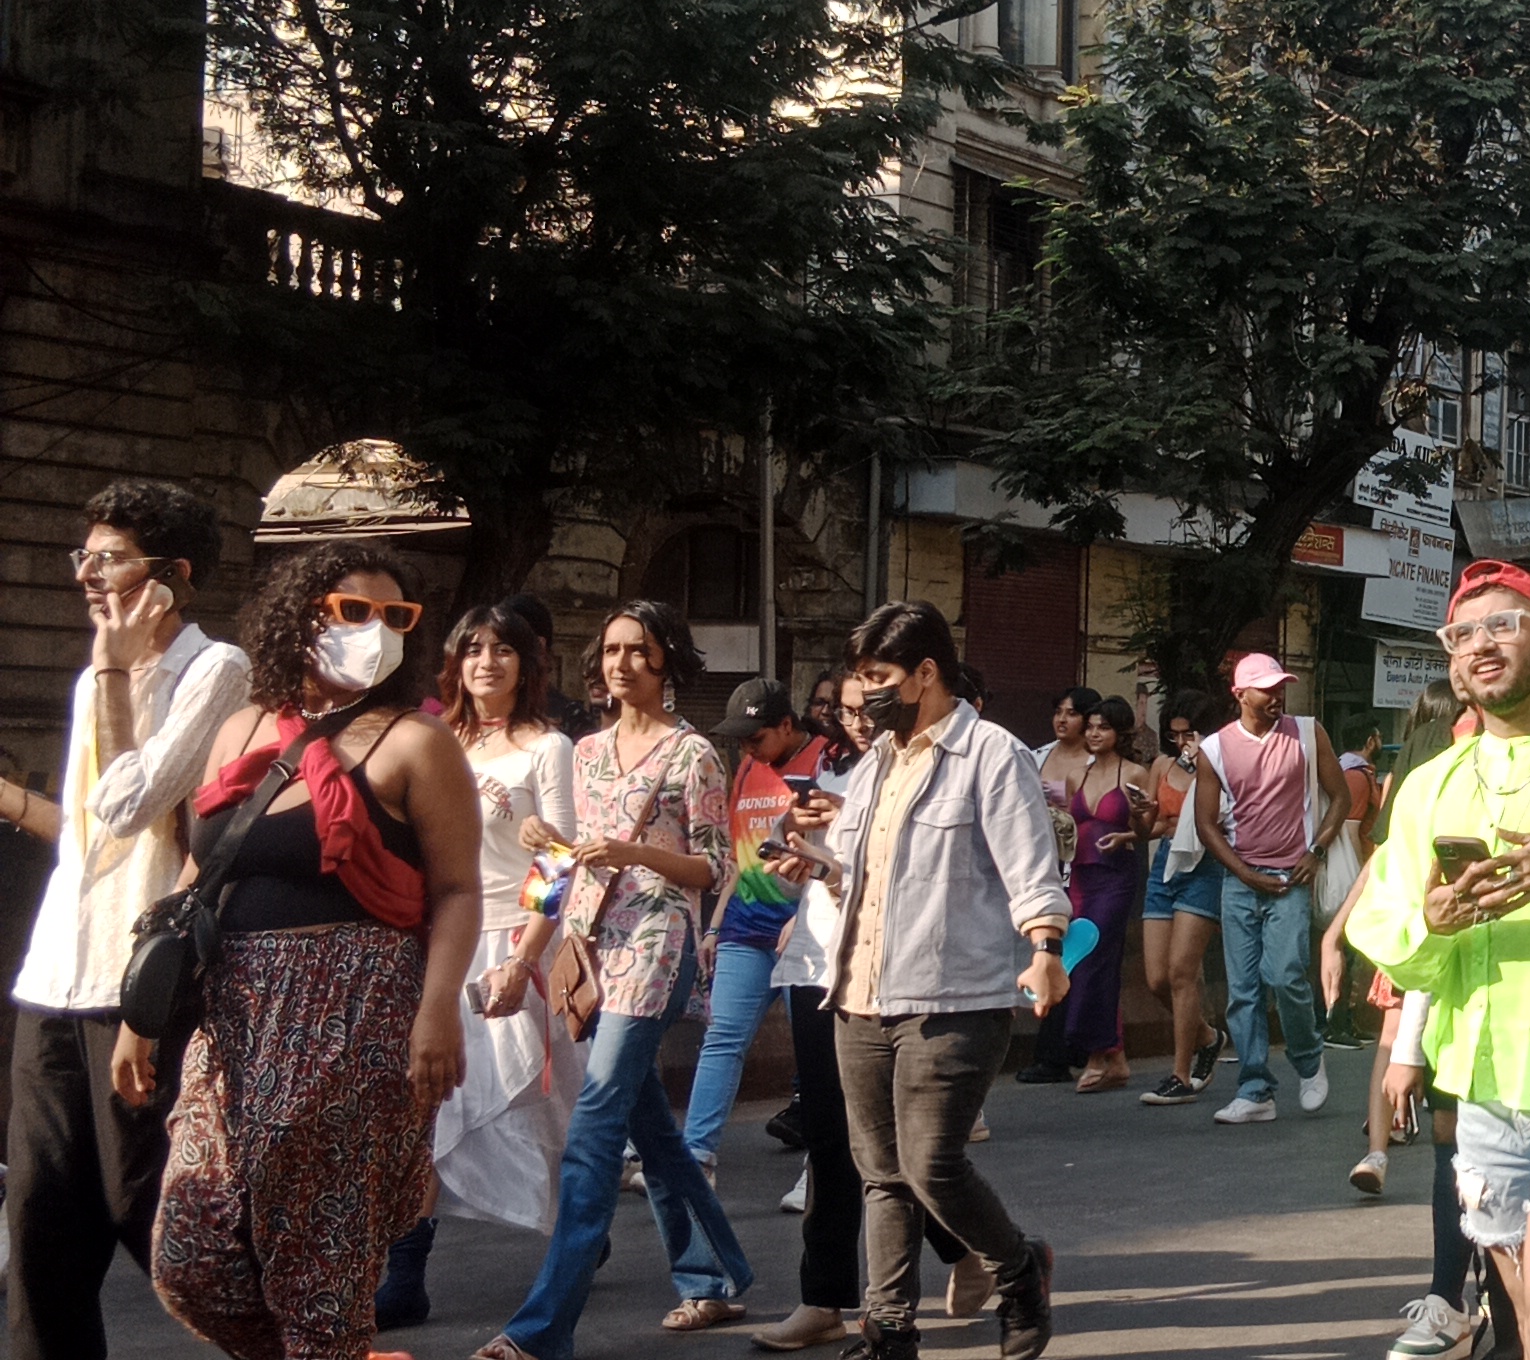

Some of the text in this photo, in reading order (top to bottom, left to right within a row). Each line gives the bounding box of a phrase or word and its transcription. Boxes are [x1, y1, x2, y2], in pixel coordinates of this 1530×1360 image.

[1389, 558, 1450, 588] ICATE FINANCE
[737, 796, 777, 811] OUNDS
